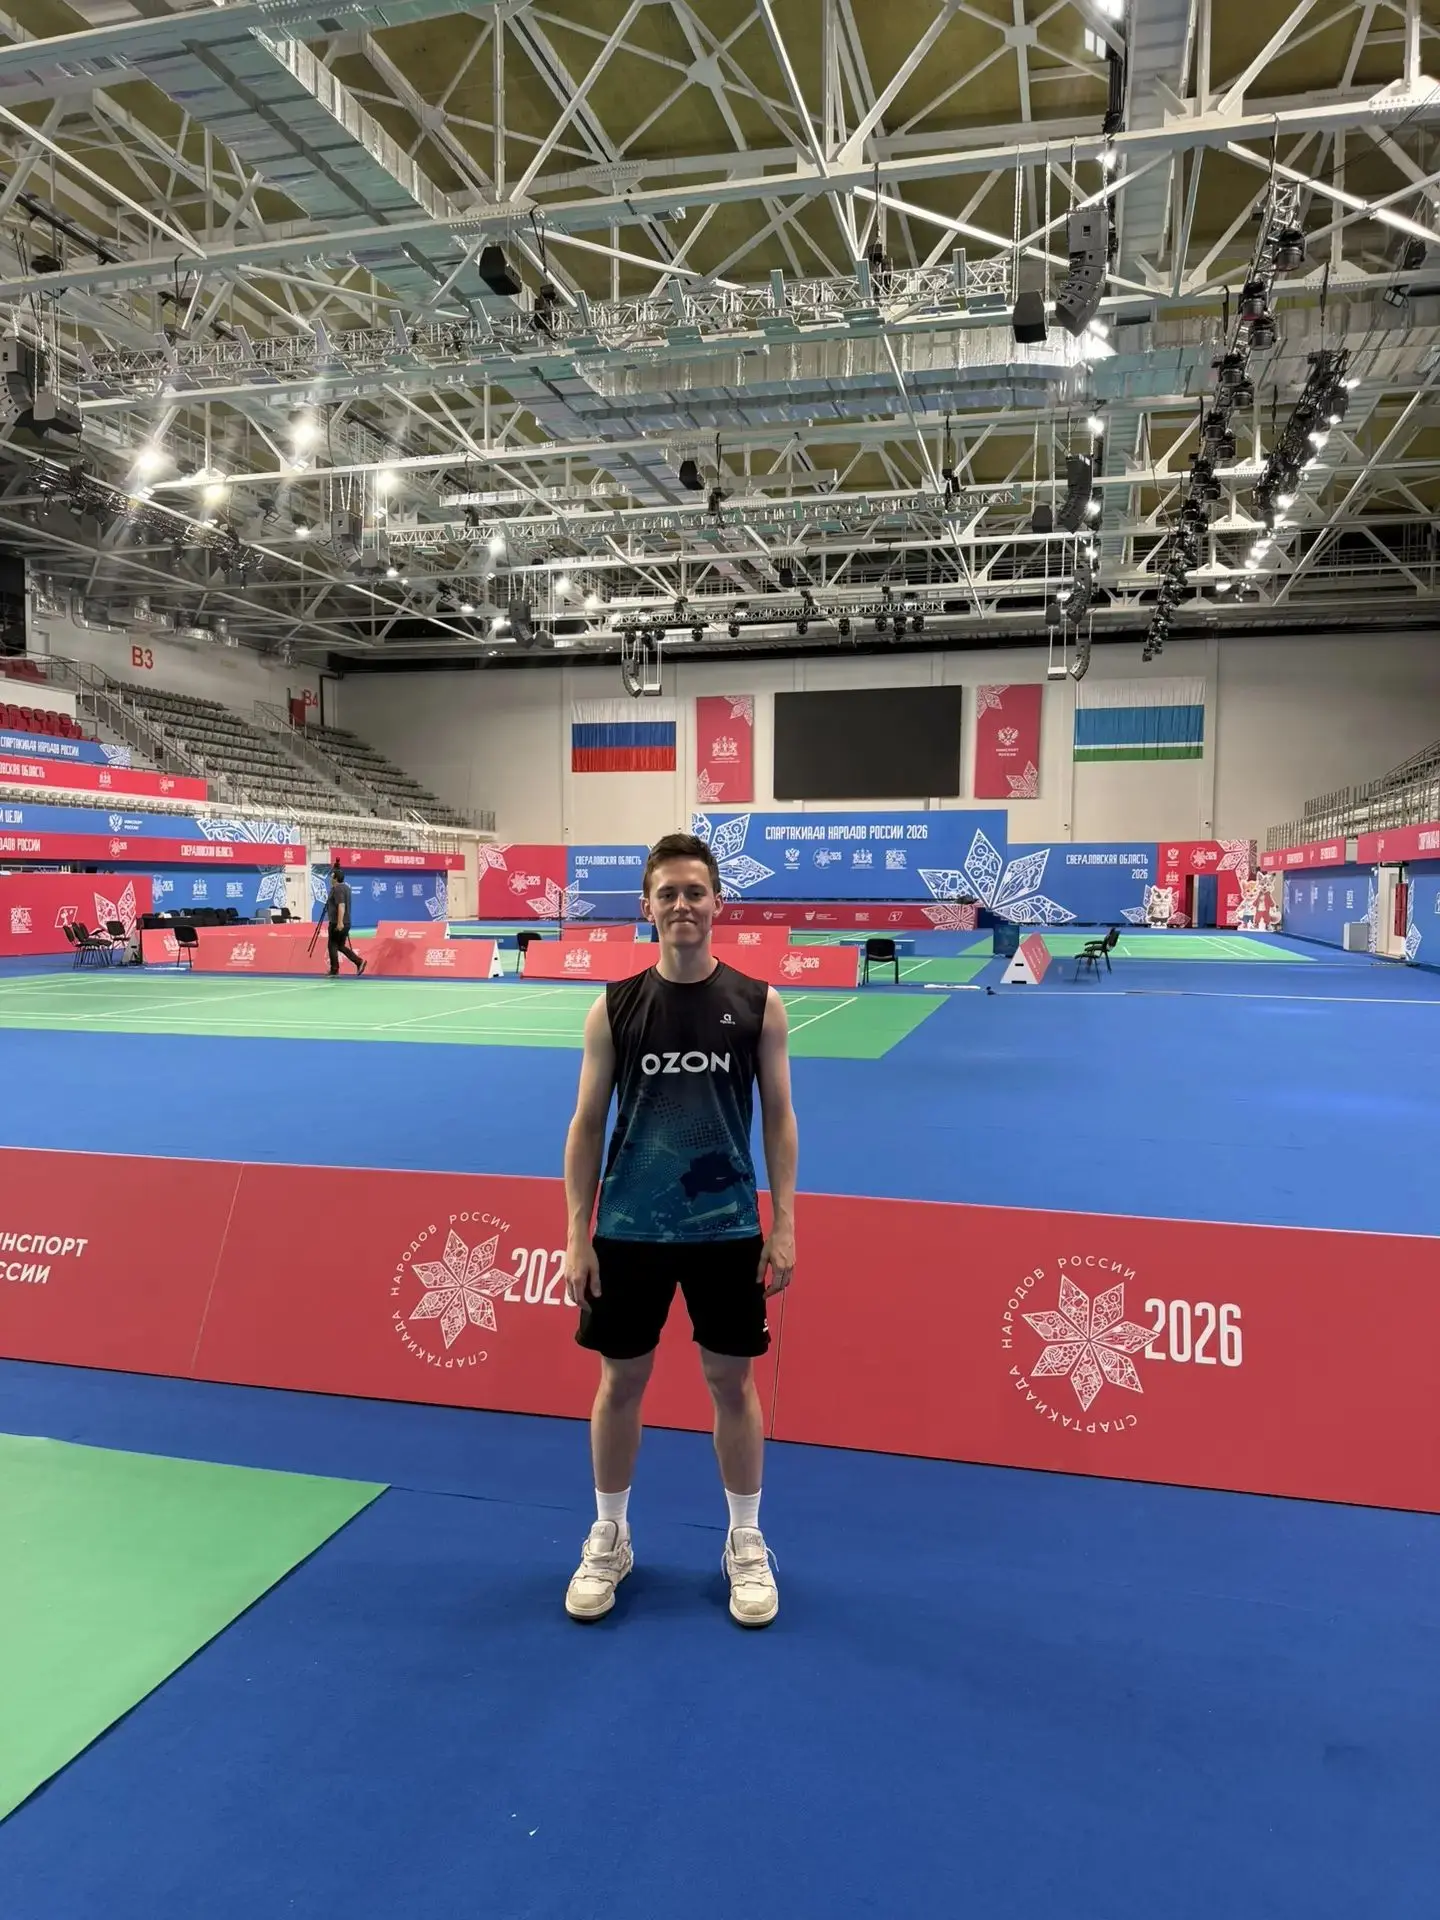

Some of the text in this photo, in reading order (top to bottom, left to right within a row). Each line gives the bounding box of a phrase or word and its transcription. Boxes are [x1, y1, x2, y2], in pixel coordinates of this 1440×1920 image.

[765, 824, 929, 841] СПАРТАКИАДА НАРОДОВ РОССИИ 2026
[575, 855, 642, 866] СВЕРДЛОВСКАЯ ОБЛАСТЬ
[1066, 853, 1149, 865] СВЕРДЛОВСКАЯ ОБЛАСТЬ
[575, 868, 589, 879] 2026
[1131, 868, 1149, 880] 2026
[801, 957, 820, 969] 2026
[641, 1050, 731, 1076] OZON
[503, 1247, 578, 1308] 202
[390, 1211, 511, 1369] СПАРТАКИАДА НАРОДОВ РОССИИ
[1144, 1297, 1243, 1368] 2026
[1001, 1254, 1138, 1434] СПАРТАКИАДА НАРОДОВ РОССИИ
